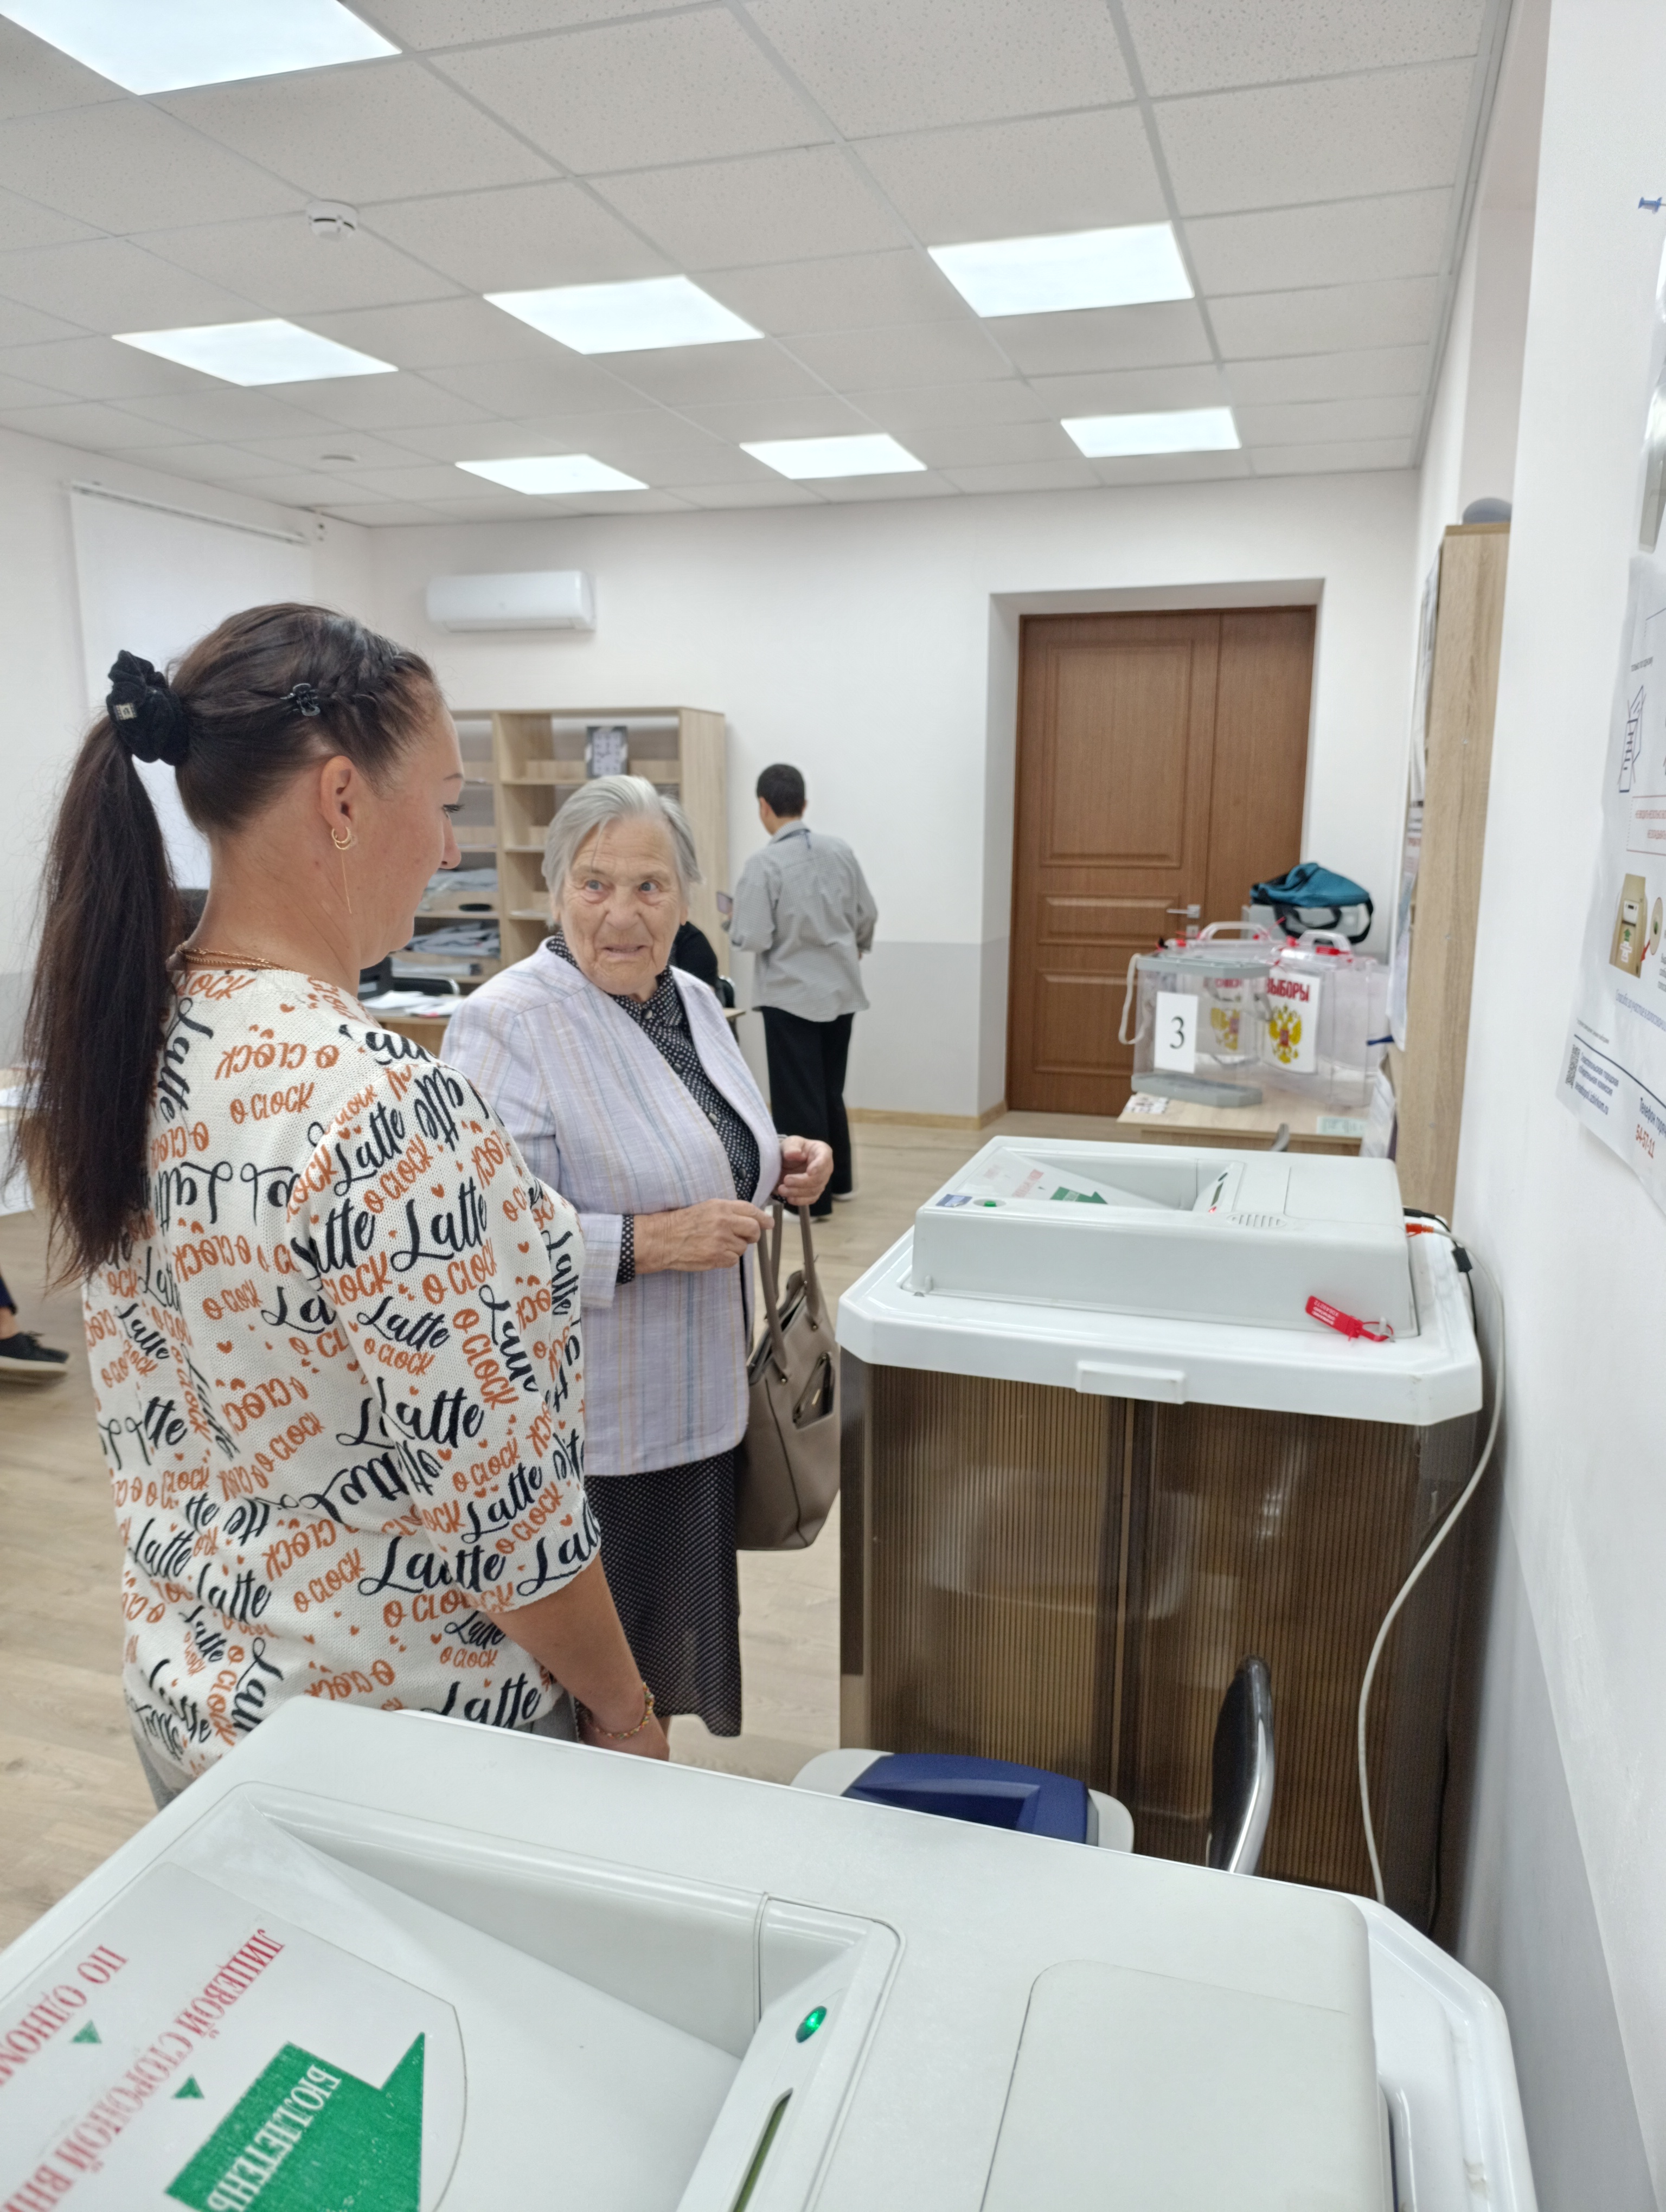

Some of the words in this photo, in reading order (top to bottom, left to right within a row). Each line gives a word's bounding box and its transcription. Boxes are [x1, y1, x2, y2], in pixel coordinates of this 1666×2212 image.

[1169, 1015, 1185, 1050] 3
[334, 1101, 406, 1197] Latte
[390, 1176, 487, 1272] Latte
[356, 1296, 451, 1352] Latte
[461, 1462, 543, 1545] Latte
[420, 1673, 542, 1731] Latte
[77, 1943, 130, 1986] ПО
[173, 1927, 286, 2041] ЛИЦЕВОЙ
[55, 2030, 195, 2175] СТОРОНОЙ
[207, 2062, 343, 2212] БЮЛЛЕТЕНЬ
